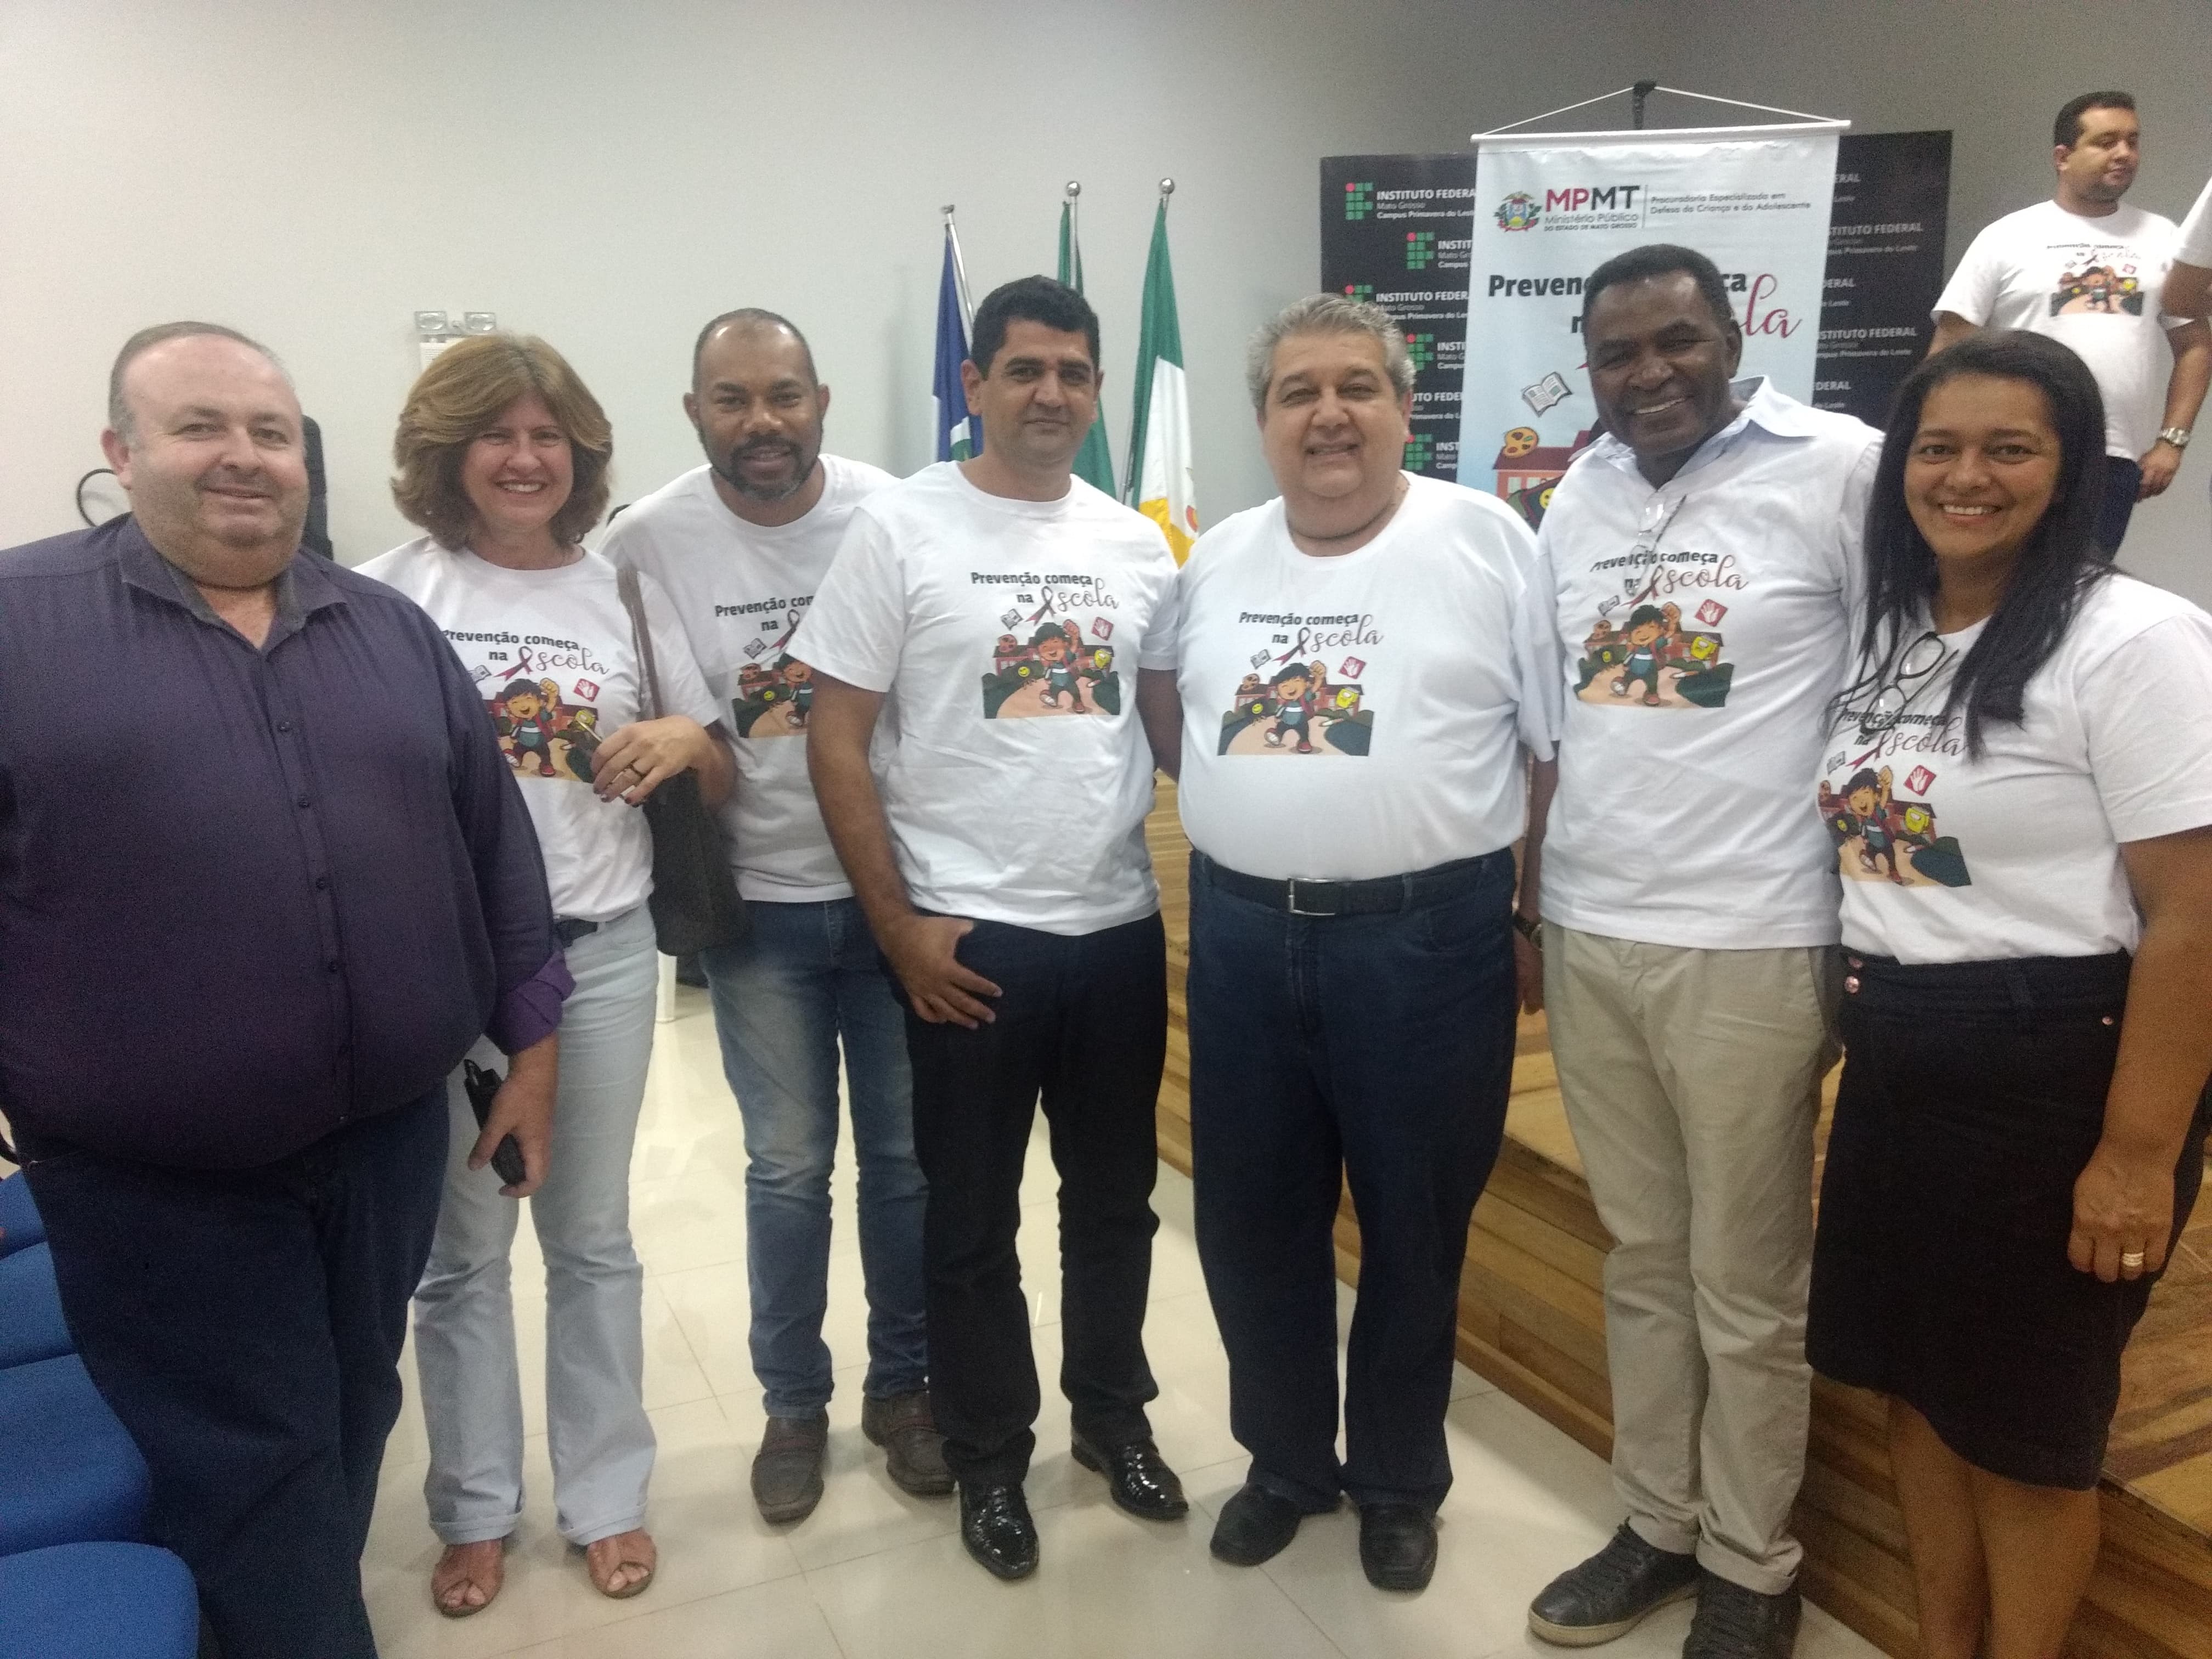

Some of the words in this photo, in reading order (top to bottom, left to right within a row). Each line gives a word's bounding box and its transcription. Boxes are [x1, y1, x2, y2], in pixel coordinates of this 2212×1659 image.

[1376, 189, 1434, 200] INSTITUTO
[1436, 189, 1476, 199] FEDERA
[1545, 185, 1640, 212] MPMT
[1544, 213, 1594, 224] Ministério
[1596, 212, 1639, 222] Público
[1438, 240, 1472, 250] INSTIT
[1488, 275, 1587, 297] Preven
[1376, 292, 1433, 302] INSTITUTO
[1435, 291, 1469, 301] FEDER
[1869, 328, 1918, 338] FEDERAL
[1815, 381, 1851, 391] DERAL
[1660, 551, 1718, 565] começa
[970, 572, 1041, 586] Prevenção
[1045, 574, 1093, 587] começa
[1017, 594, 1034, 603] na
[715, 597, 786, 617] Prevenção
[1239, 612, 1302, 627] Prevenção
[1306, 614, 1358, 627] começa
[761, 620, 778, 631] na
[525, 636, 579, 651] começa
[1272, 634, 1288, 644] na
[489, 651, 508, 661] na
